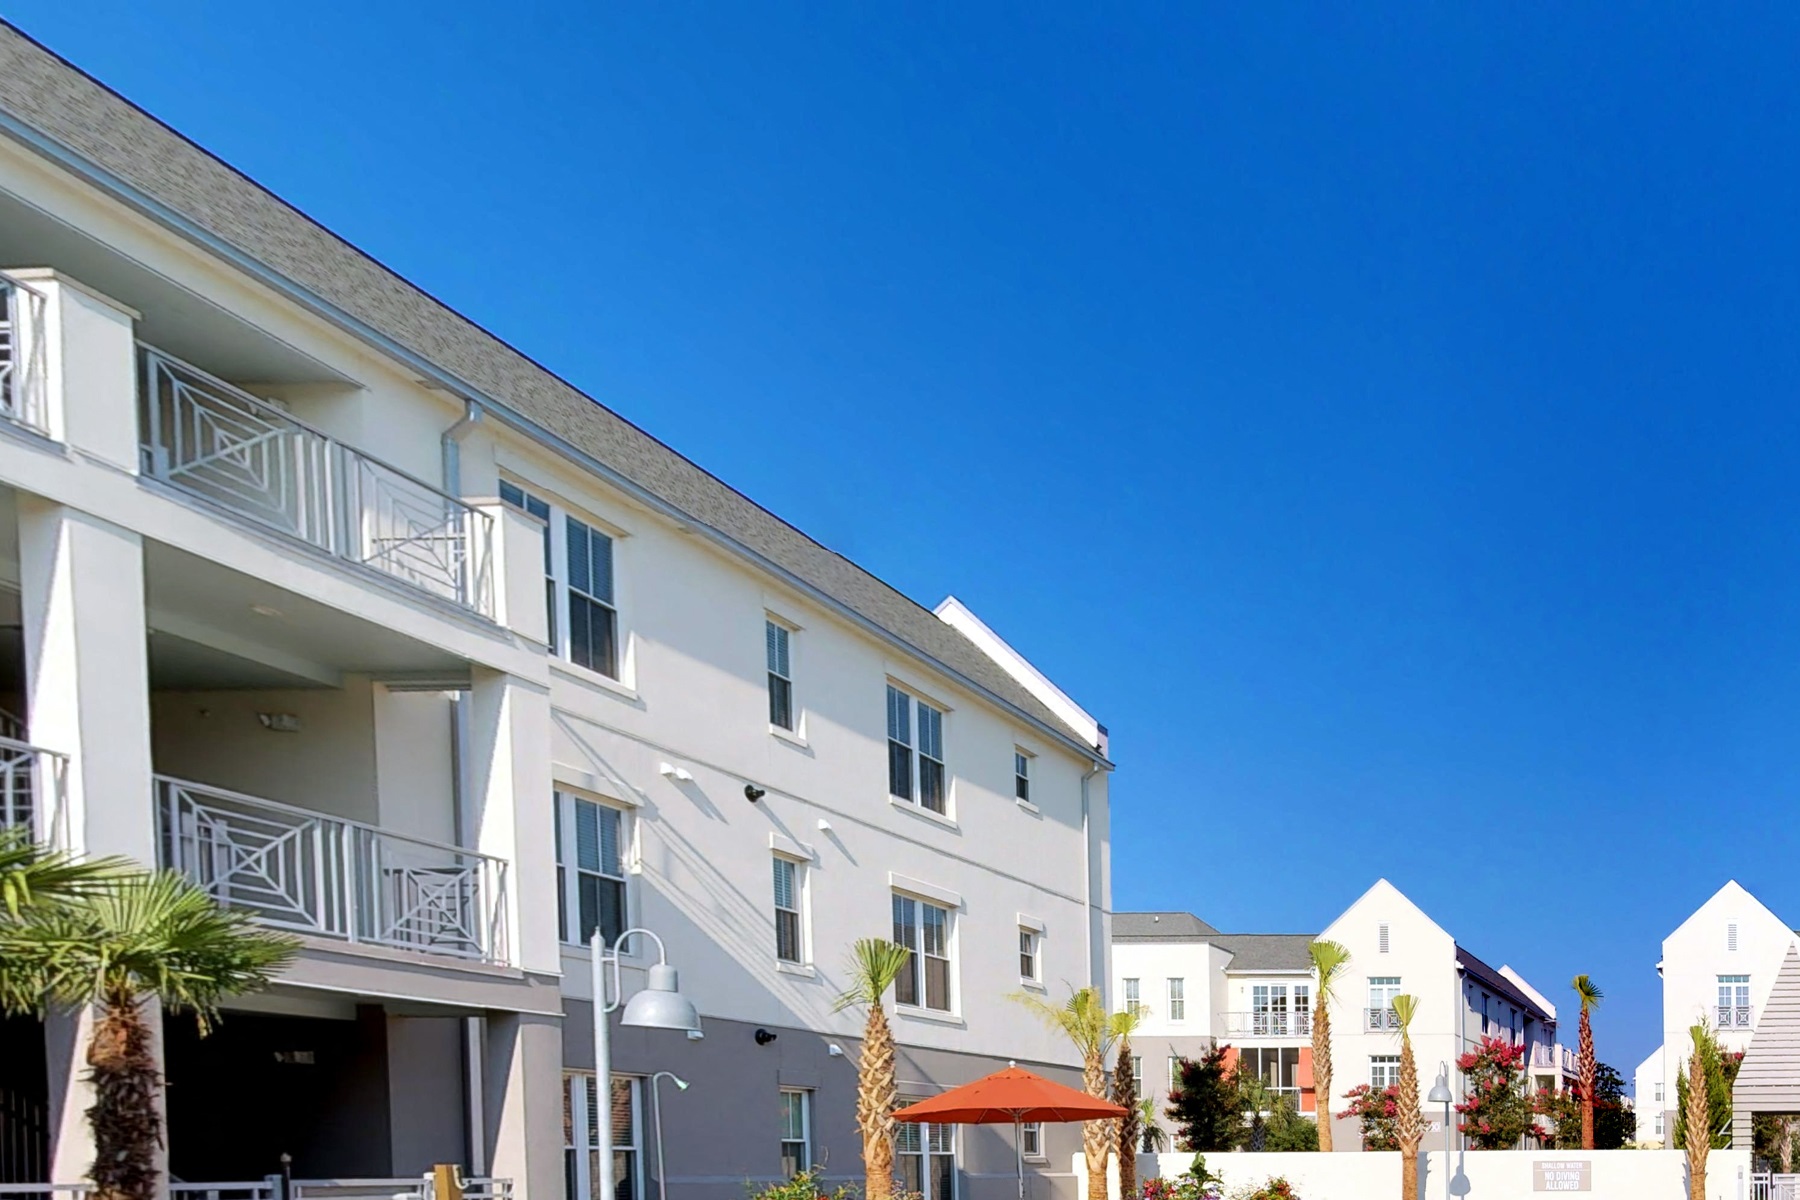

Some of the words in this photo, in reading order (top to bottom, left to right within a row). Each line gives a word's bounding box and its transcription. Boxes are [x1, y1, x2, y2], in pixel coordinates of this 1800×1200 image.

[1544, 1171, 1554, 1180] NO
[1556, 1171, 1580, 1180] DIVING
[1545, 1180, 1579, 1190] ALLOWED
